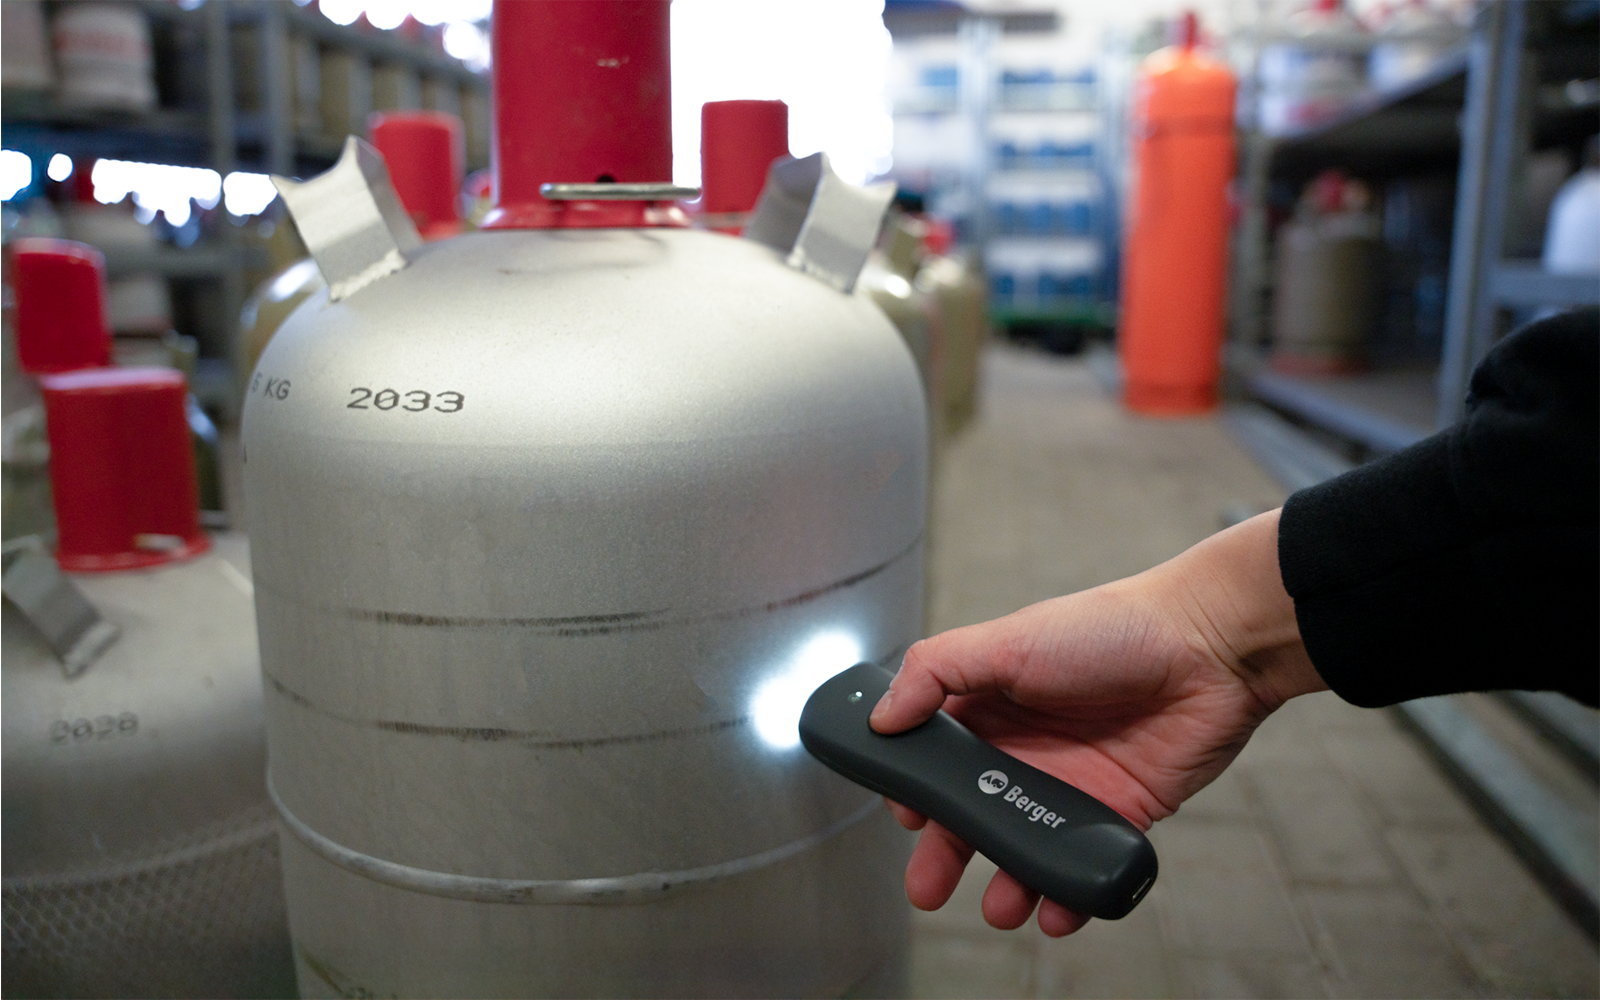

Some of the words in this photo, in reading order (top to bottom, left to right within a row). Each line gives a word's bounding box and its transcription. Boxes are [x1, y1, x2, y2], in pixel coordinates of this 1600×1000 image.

[264, 377, 291, 400] KG
[347, 387, 465, 413] 2033
[1003, 785, 1066, 829] Berger
